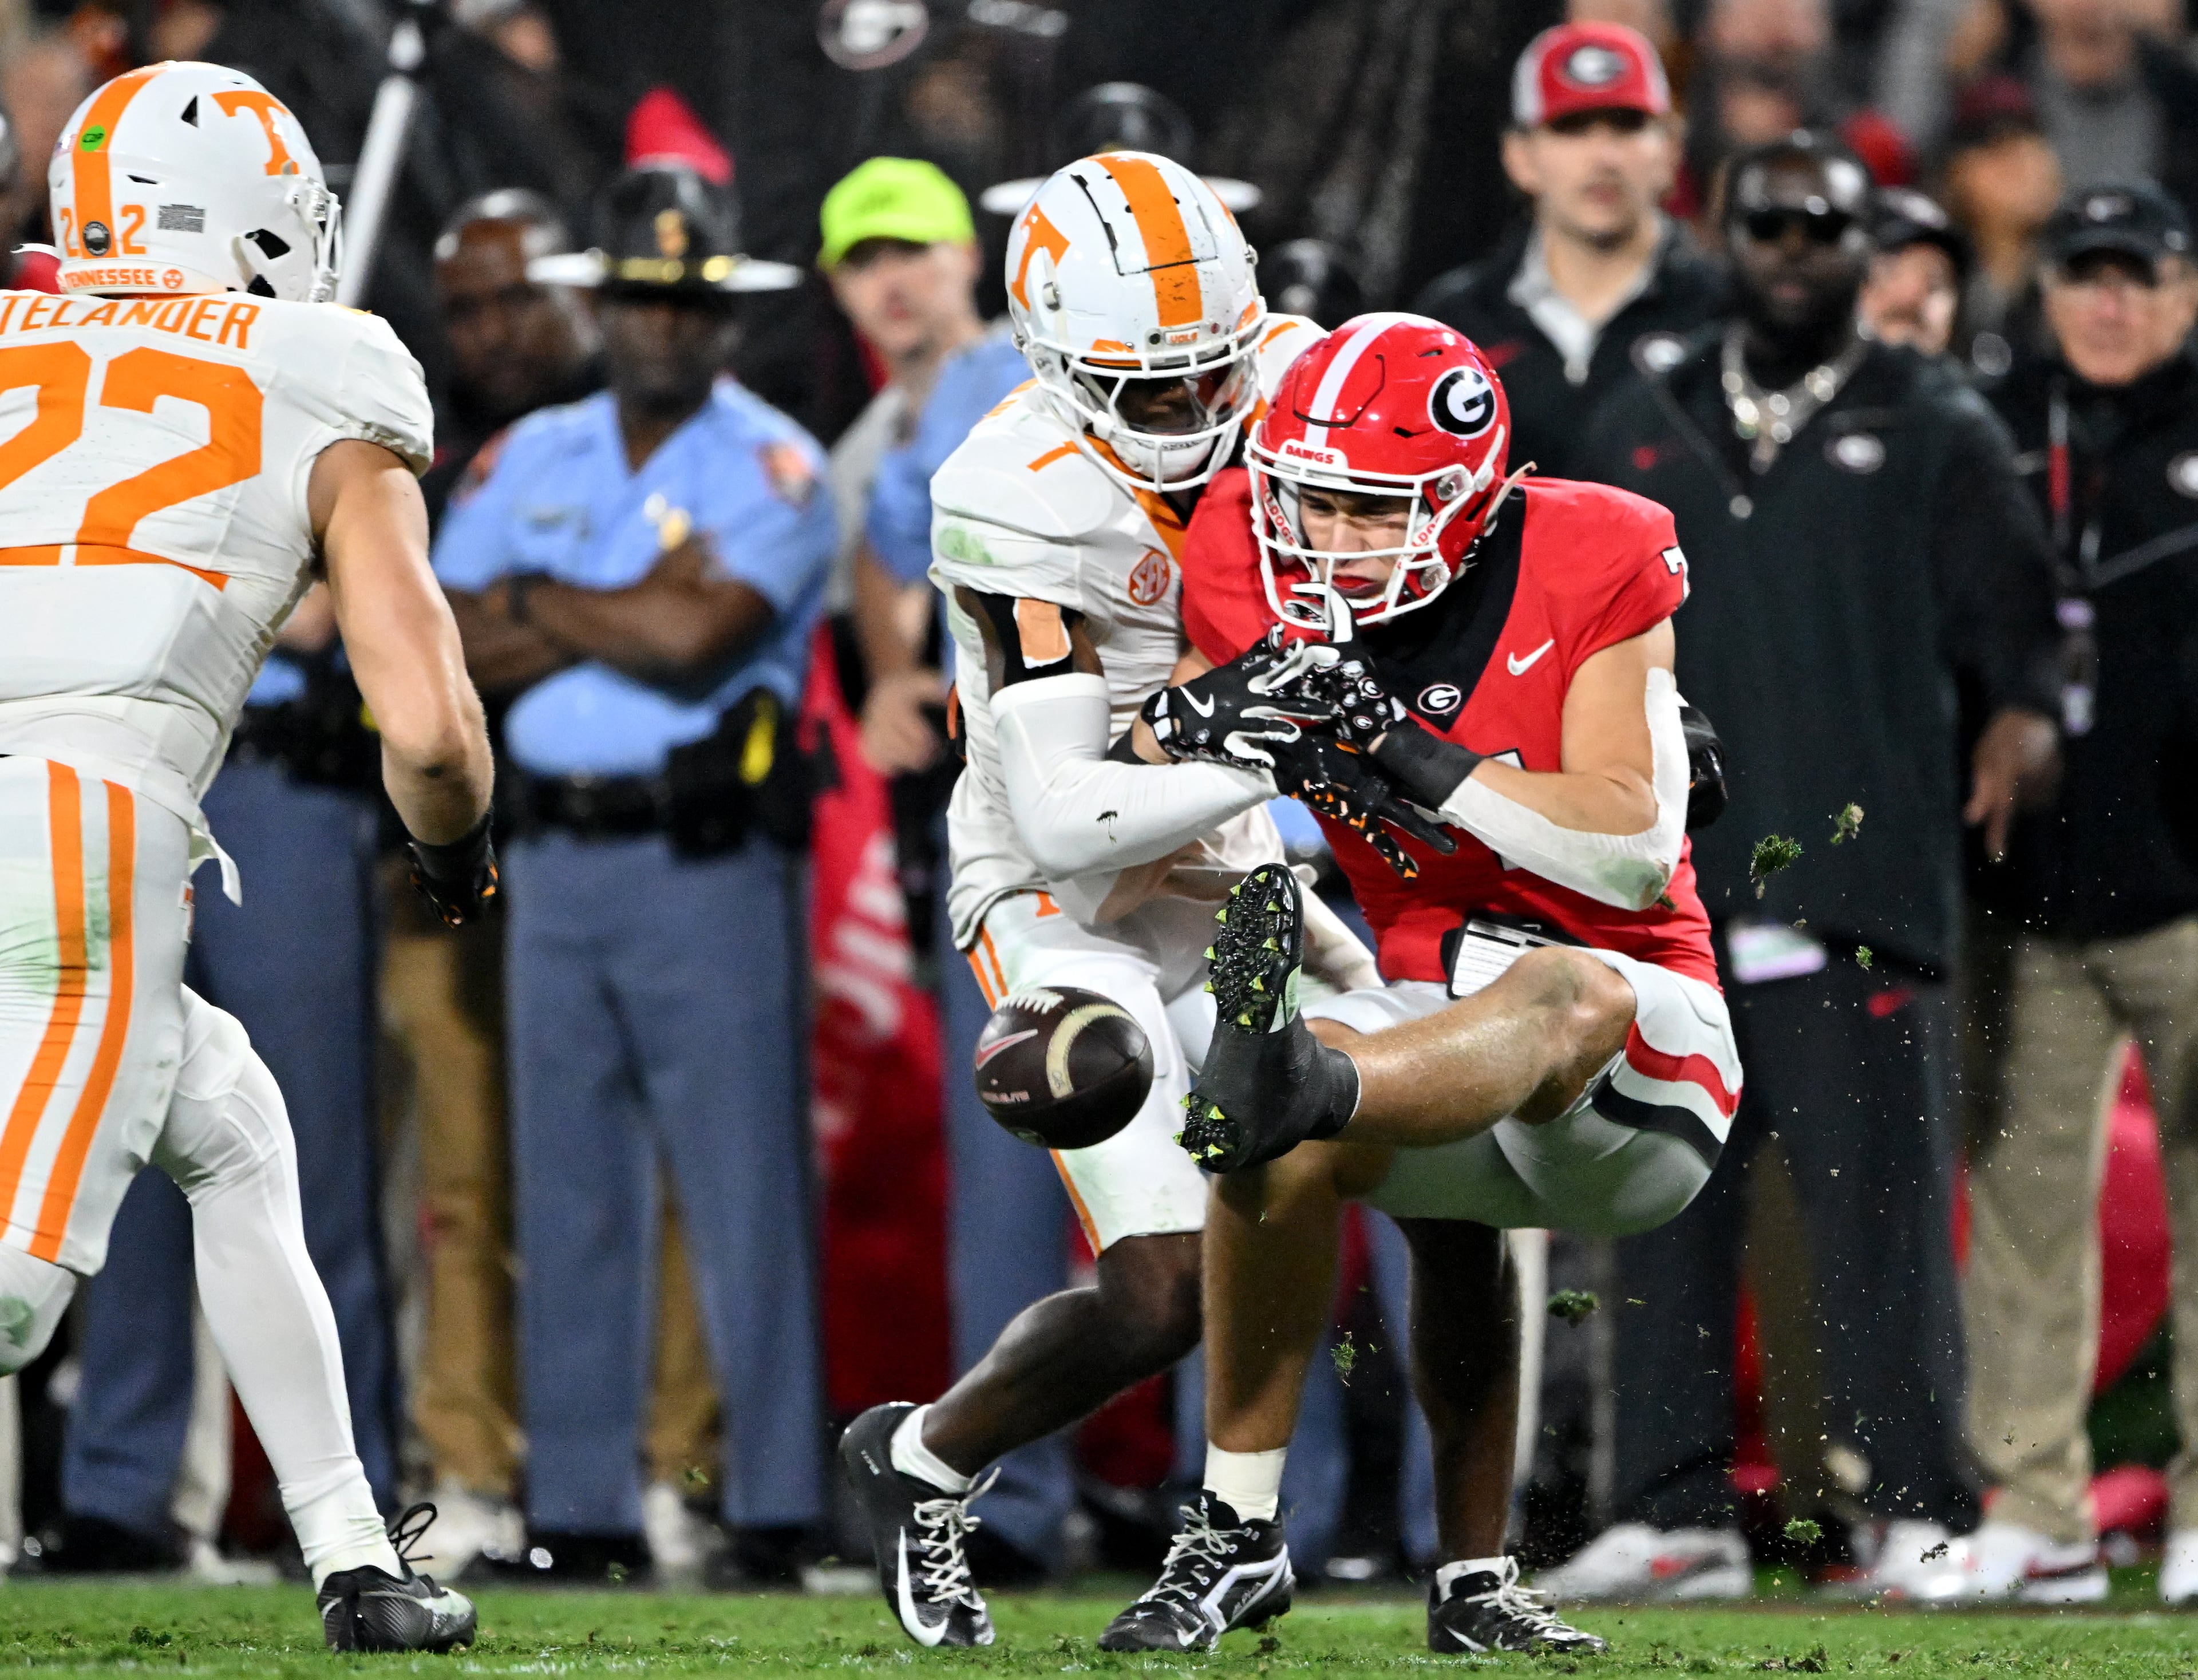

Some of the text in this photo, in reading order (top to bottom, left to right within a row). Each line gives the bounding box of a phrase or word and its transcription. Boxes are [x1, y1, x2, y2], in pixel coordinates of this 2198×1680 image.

[212, 90, 299, 175] T
[1011, 202, 1070, 311] T
[1430, 369, 1496, 437] G
[0, 340, 264, 592] 22
[1286, 444, 1334, 464] DAWGS
[1421, 686, 1460, 711] G
